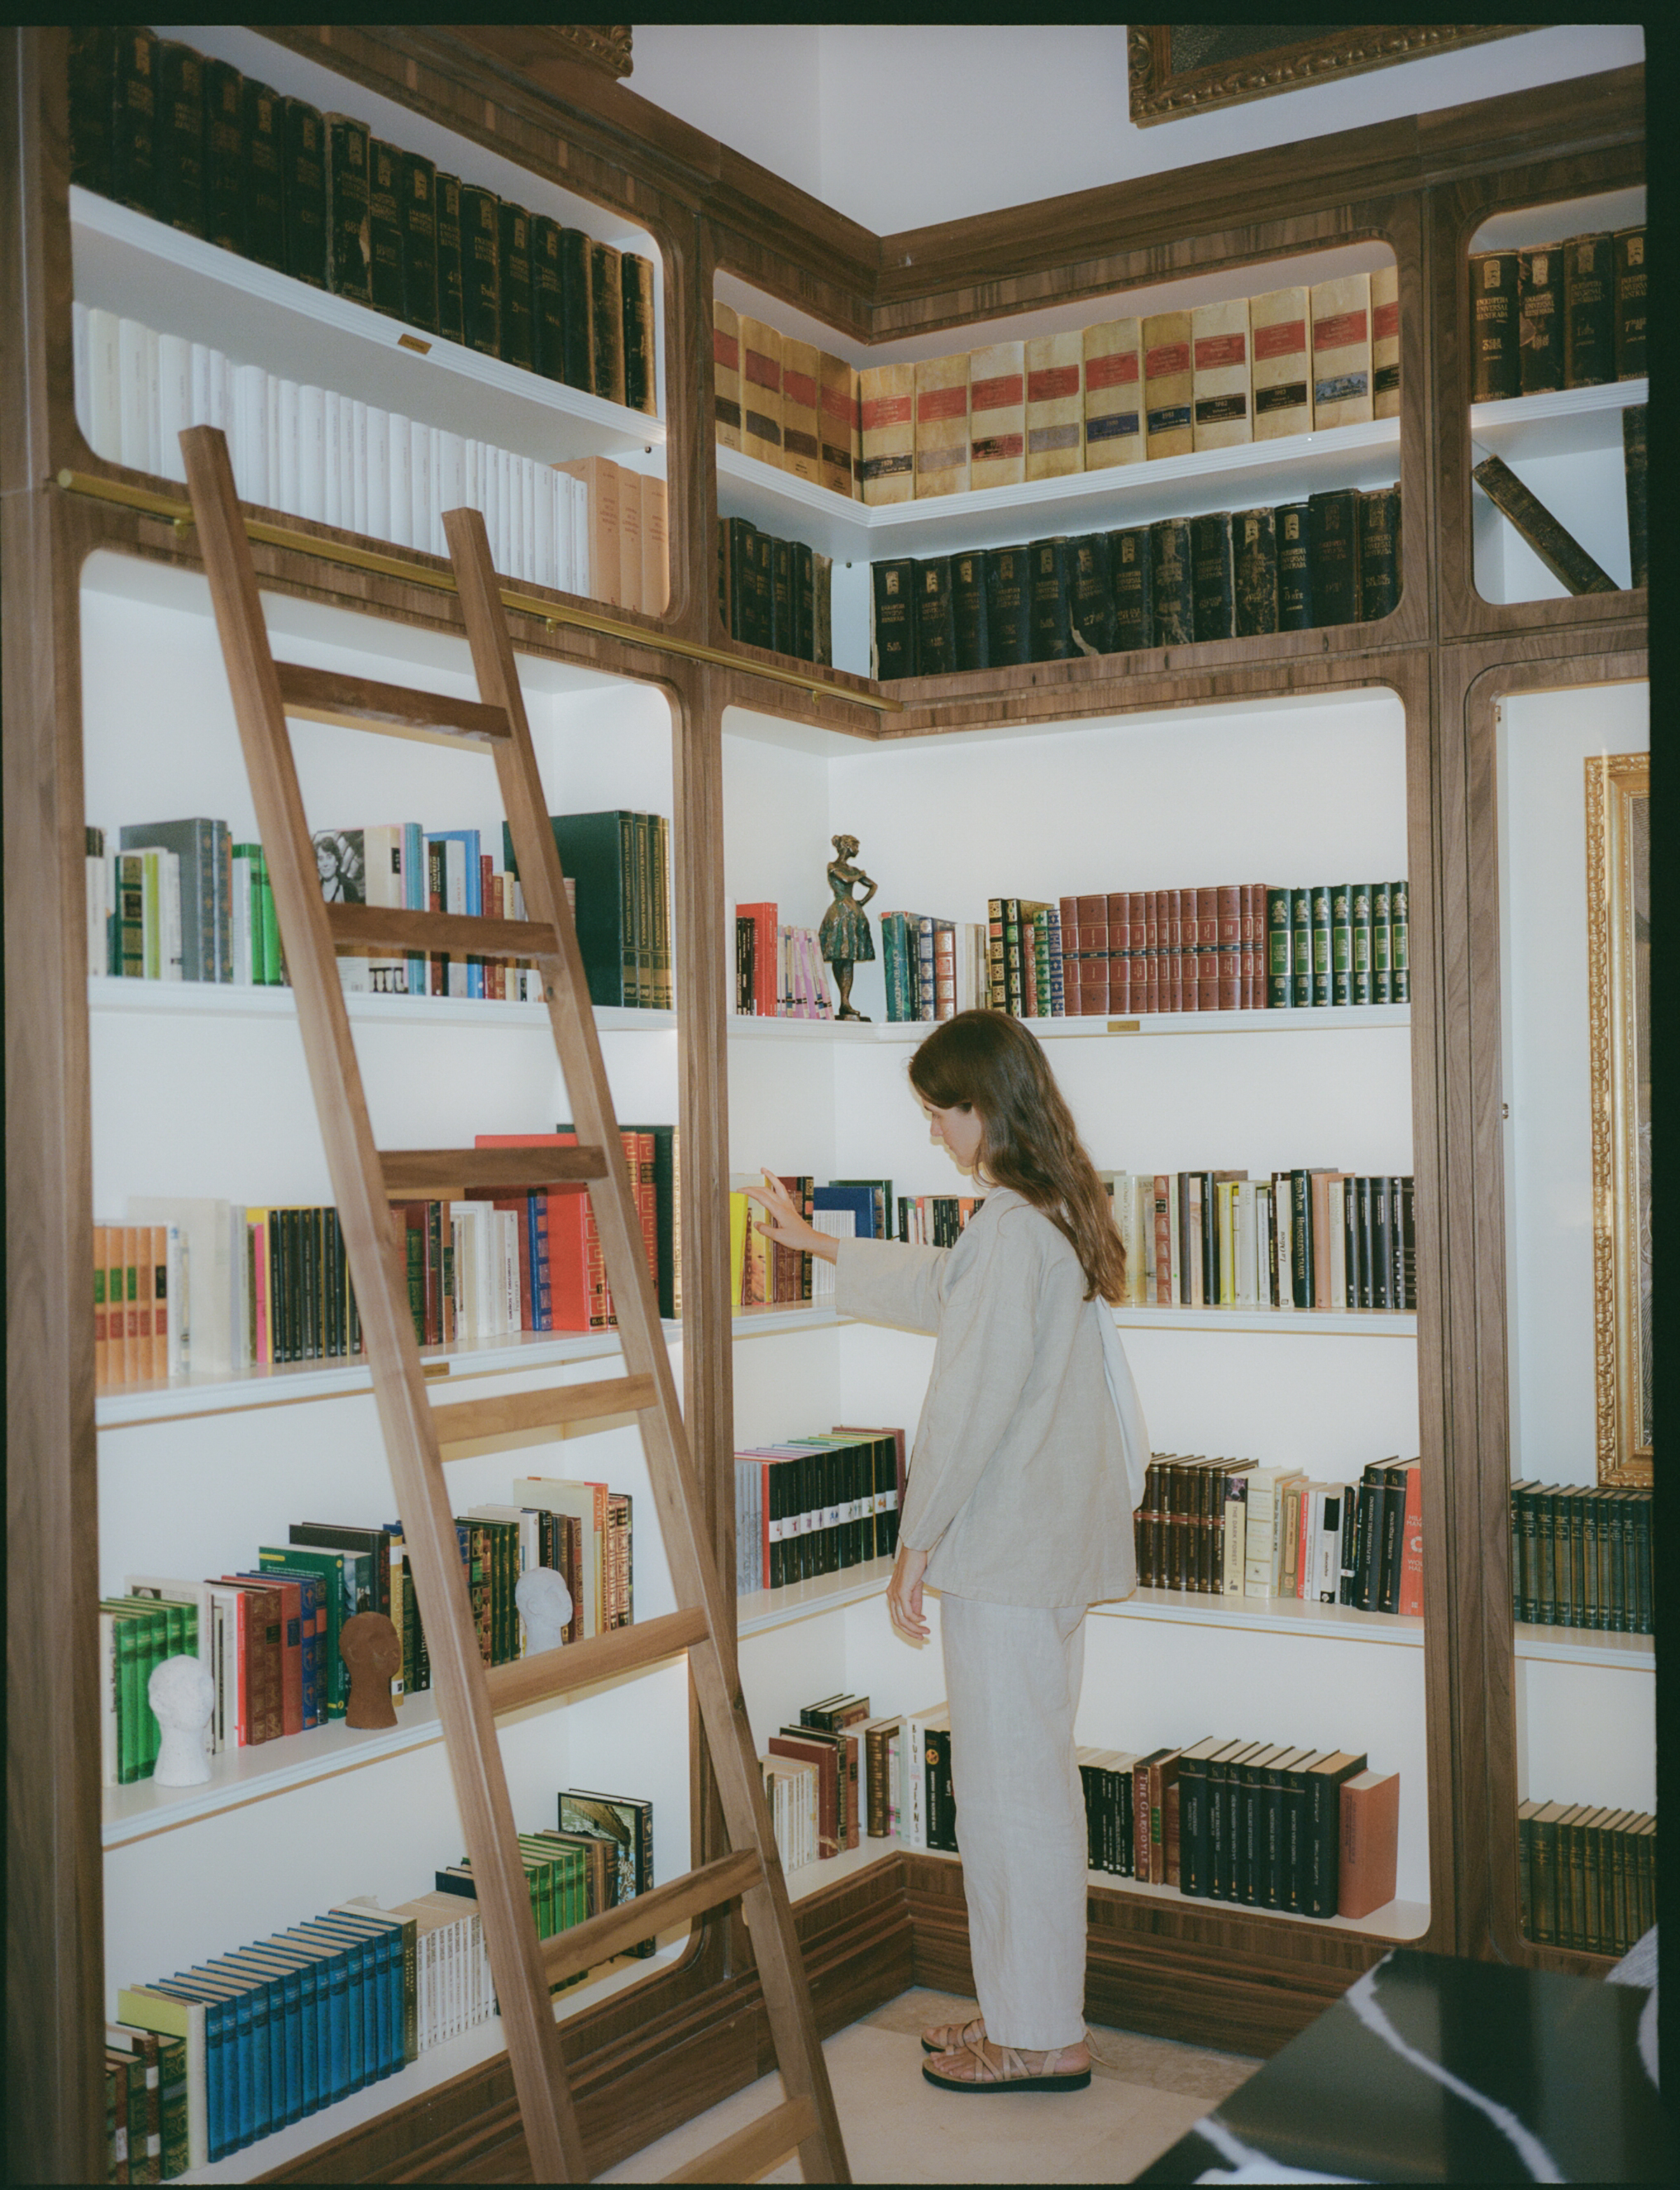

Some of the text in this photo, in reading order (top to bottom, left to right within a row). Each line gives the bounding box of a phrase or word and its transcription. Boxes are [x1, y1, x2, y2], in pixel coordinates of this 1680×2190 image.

[1295, 1194, 1303, 1211] PLAIN
[1280, 1253, 1286, 1262] La
[1140, 1774, 1149, 1864] THE GARGOYLE
